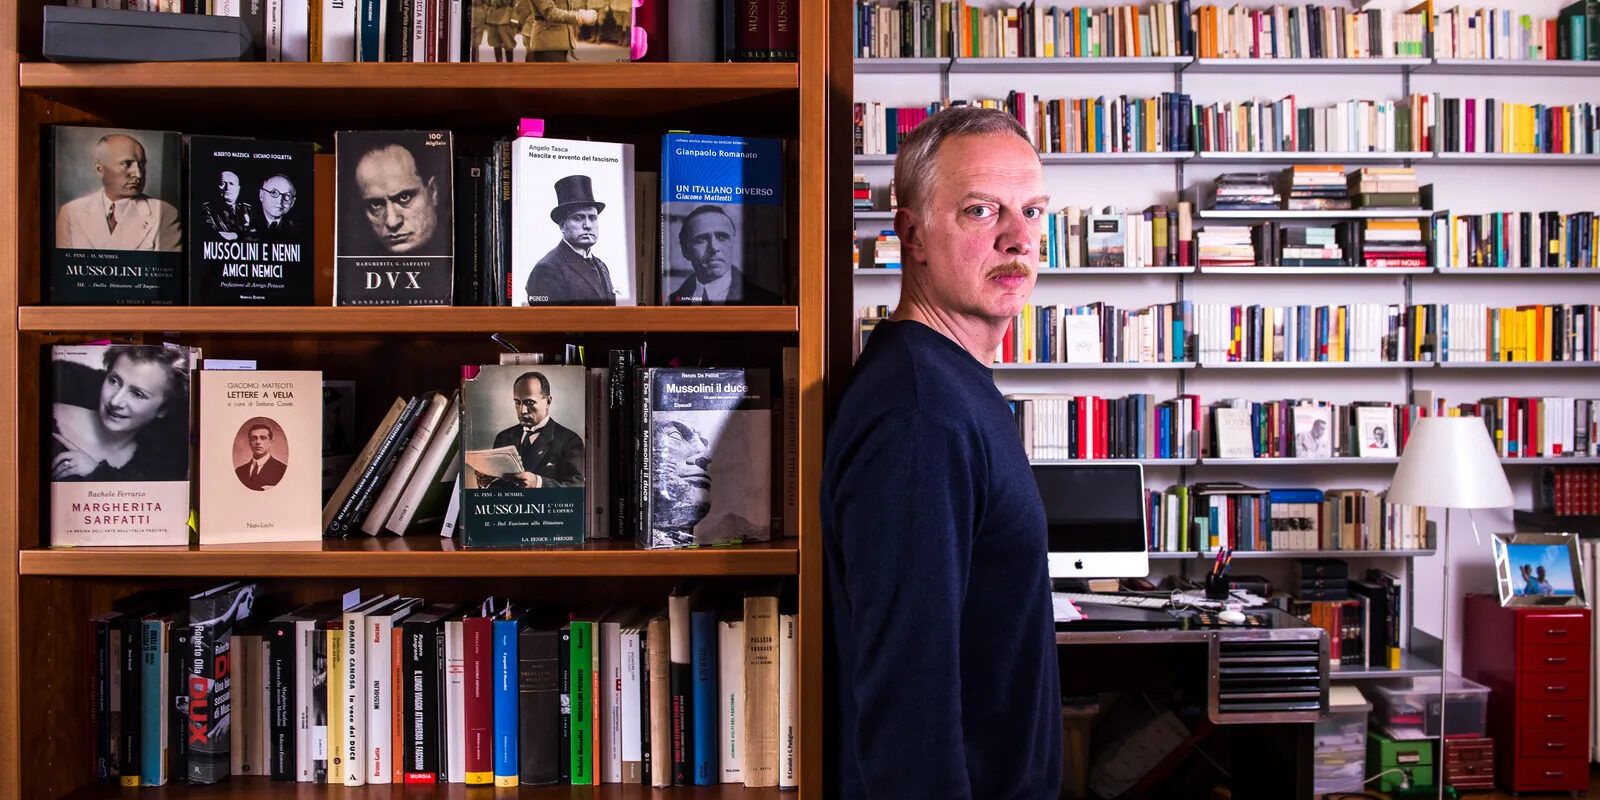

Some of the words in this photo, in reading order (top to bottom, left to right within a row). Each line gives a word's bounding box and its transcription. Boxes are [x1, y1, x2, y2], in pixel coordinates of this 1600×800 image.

[529, 145, 550, 153] Angelo
[676, 148, 717, 159] Gianpaolo
[719, 150, 758, 159] Romanato
[592, 155, 619, 163] fascismo
[502, 181, 511, 201] ROMA
[676, 185, 689, 193] UN
[692, 186, 732, 195] ITALIANO
[735, 187, 773, 196] DIVERSO
[676, 193, 703, 201] Giacomo
[704, 194, 732, 202] Matteotti
[204, 241, 259, 261] MUSSOLINI
[263, 244, 269, 261] E
[272, 244, 301, 262] NENNI
[66, 265, 142, 277] MUSSOLINI
[222, 263, 249, 277] AMICI
[252, 264, 283, 278] NEMICI
[227, 382, 259, 390] GIACOMO
[261, 382, 294, 390] MATTEOTTI
[643, 383, 649, 395] De
[666, 383, 715, 394] Mussolini
[716, 383, 722, 393] il
[723, 383, 748, 393] duce
[227, 391, 258, 399] LETTERE
[262, 391, 268, 399] A
[272, 391, 294, 399] VELIA
[118, 490, 146, 498] Ferrario
[73, 502, 163, 512] MARGHERITA
[474, 504, 545, 515] MUSSOLINI
[85, 515, 151, 525] SARFATTI
[194, 625, 204, 657] Roberto
[194, 659, 204, 674] Olla
[414, 675, 423, 691] LUNGO
[414, 692, 423, 710] VIAGGIO
[189, 677, 209, 744] DUX
[414, 711, 423, 740] ATTRAVERSO
[414, 746, 423, 770] FASCISMO
